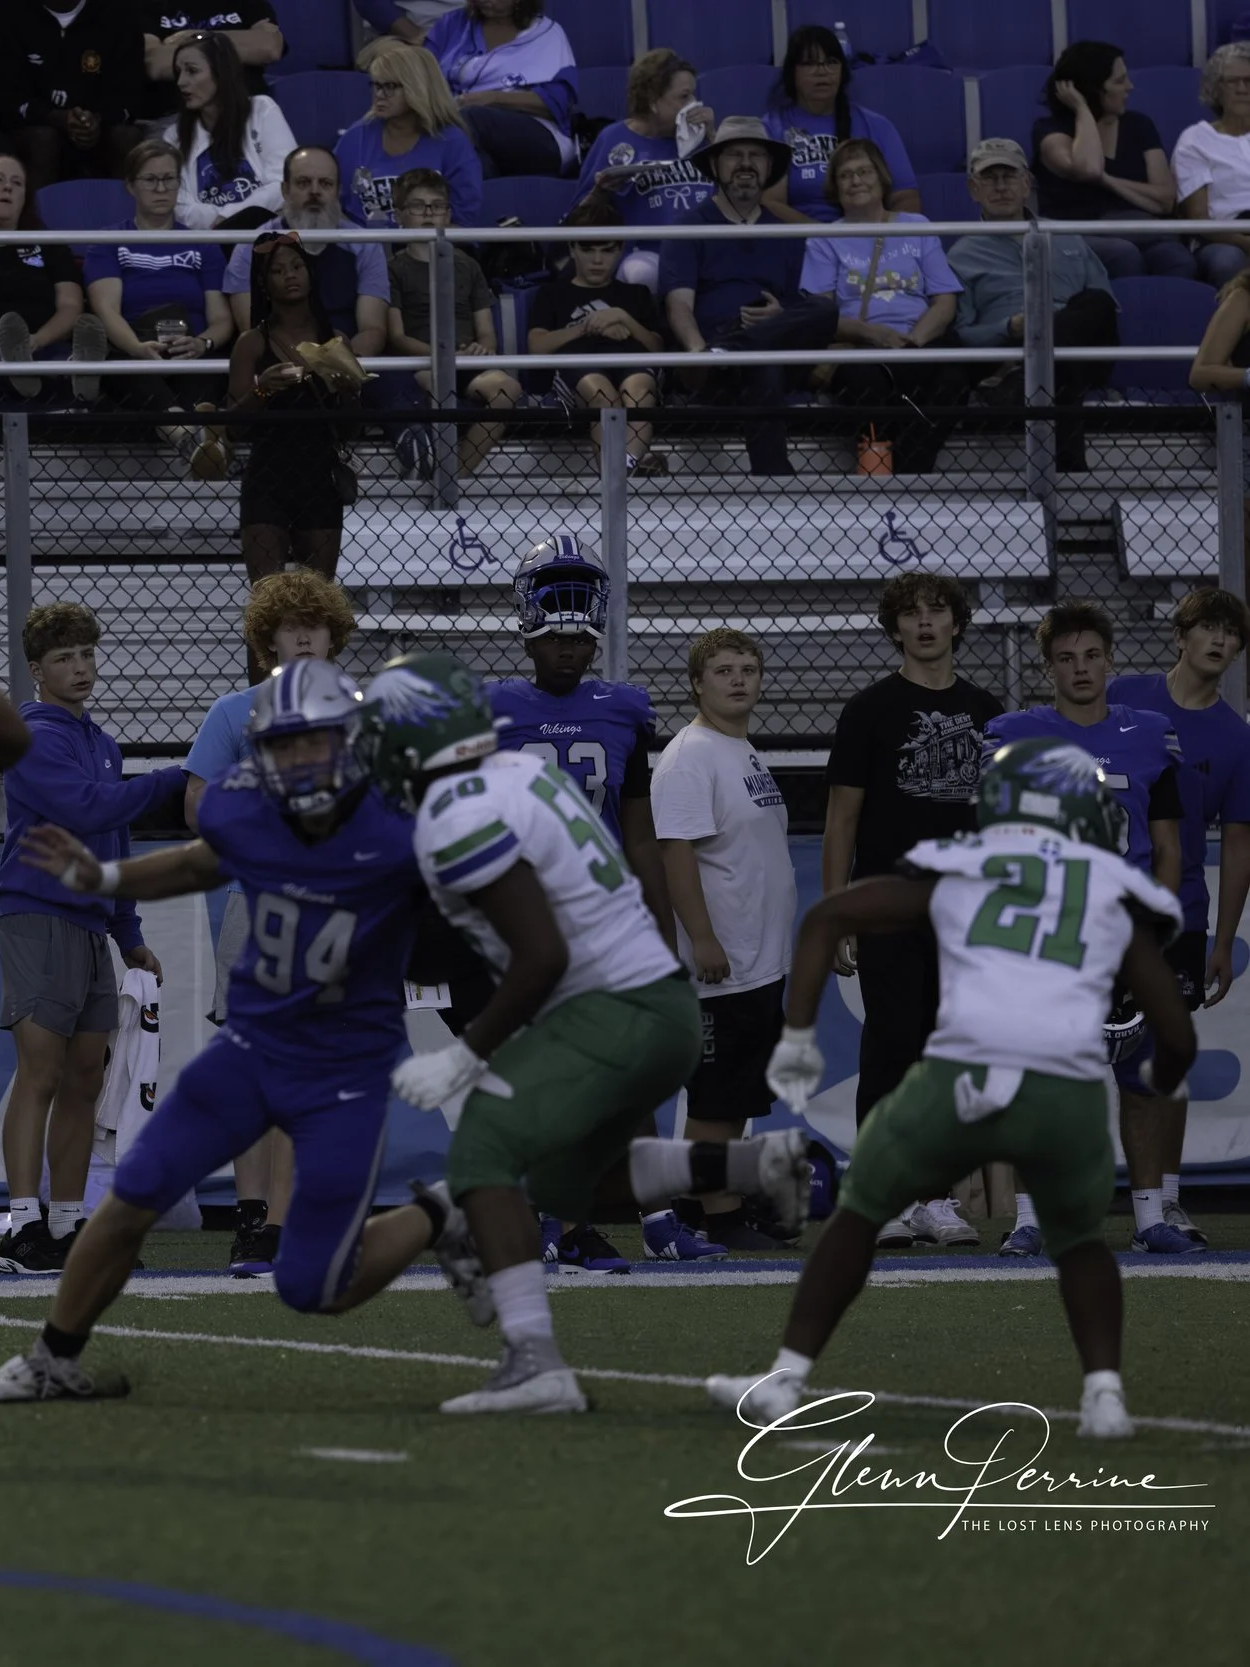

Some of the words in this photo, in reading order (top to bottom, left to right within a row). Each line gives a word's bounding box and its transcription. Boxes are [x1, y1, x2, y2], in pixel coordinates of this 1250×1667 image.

[539, 722, 583, 736] Vikings
[253, 890, 359, 1005] 94
[965, 854, 1091, 971] 21
